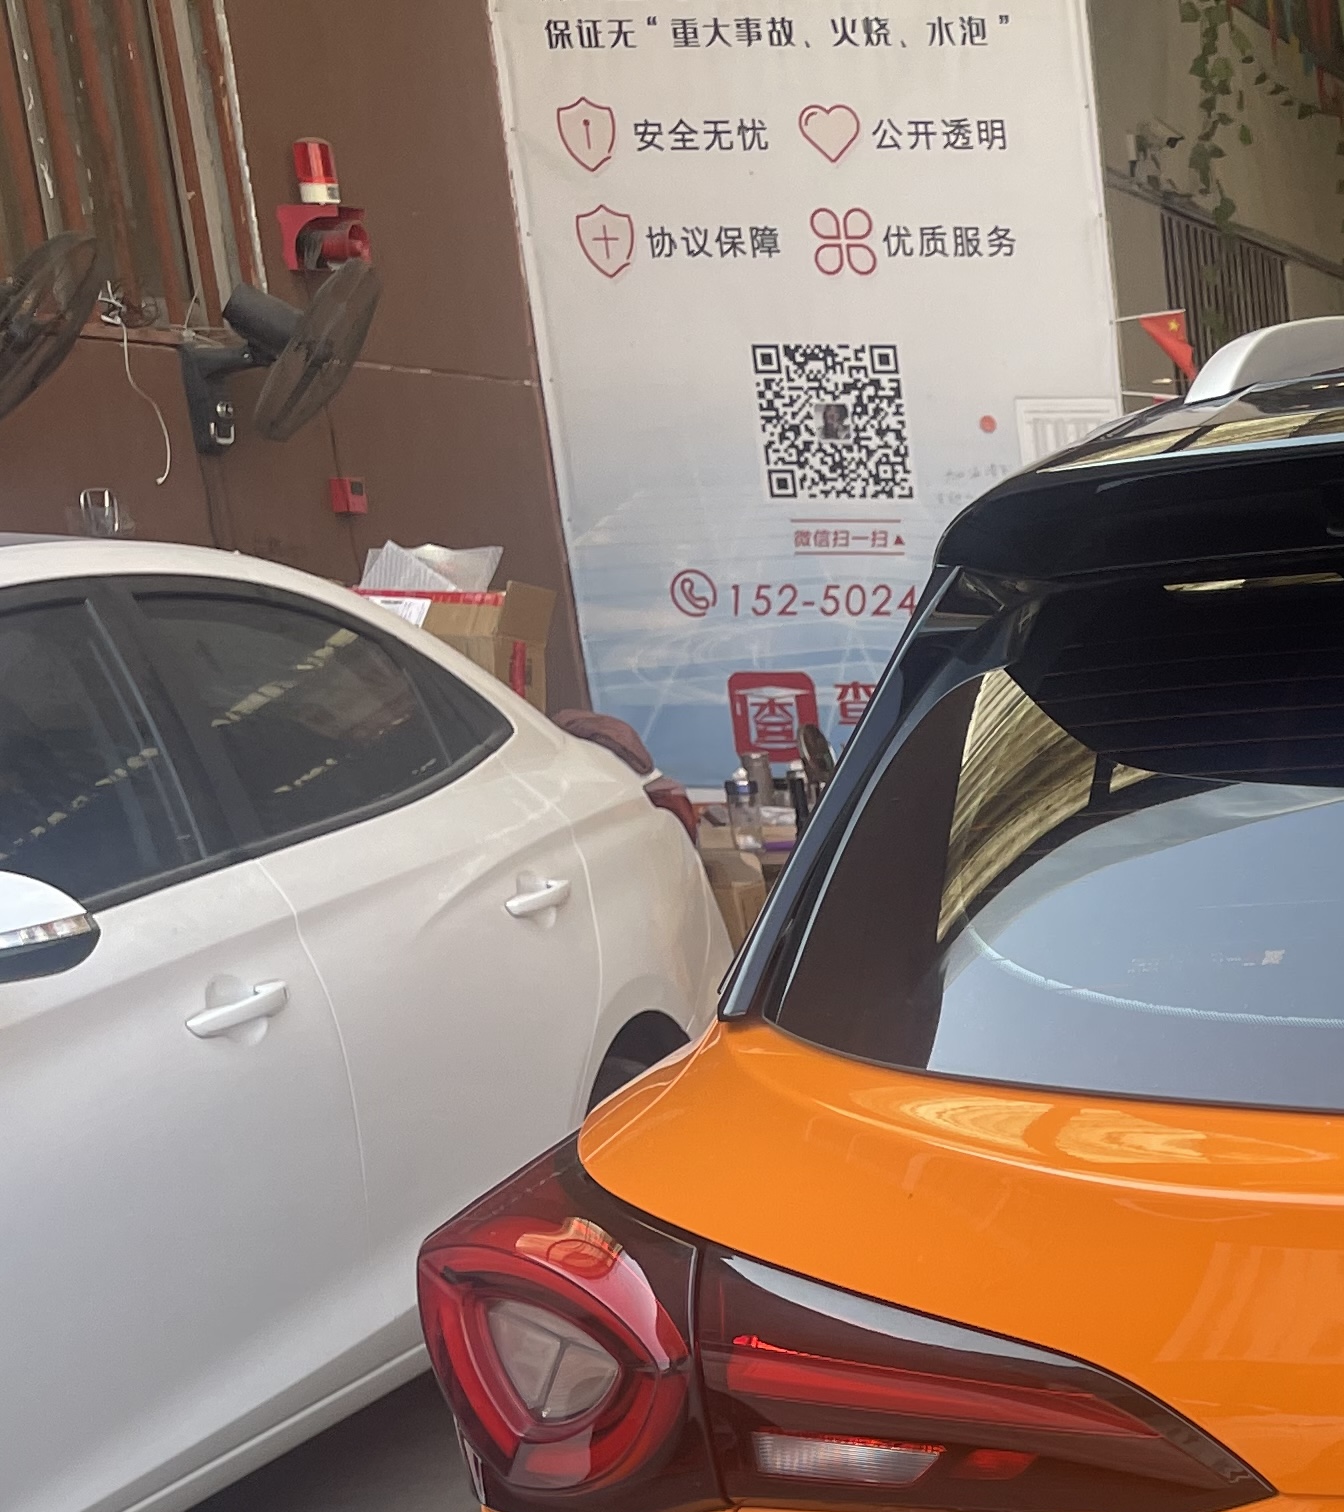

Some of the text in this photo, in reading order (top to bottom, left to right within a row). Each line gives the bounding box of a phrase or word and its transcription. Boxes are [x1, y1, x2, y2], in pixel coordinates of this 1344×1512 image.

[633, 118, 770, 152] 安全无忧
[872, 118, 1008, 152] 公开透明
[646, 225, 781, 259] 协议保障
[882, 225, 1017, 258] 优质服务
[794, 529, 888, 549] 微信扫一扫
[732, 584, 917, 618] 152-5024
